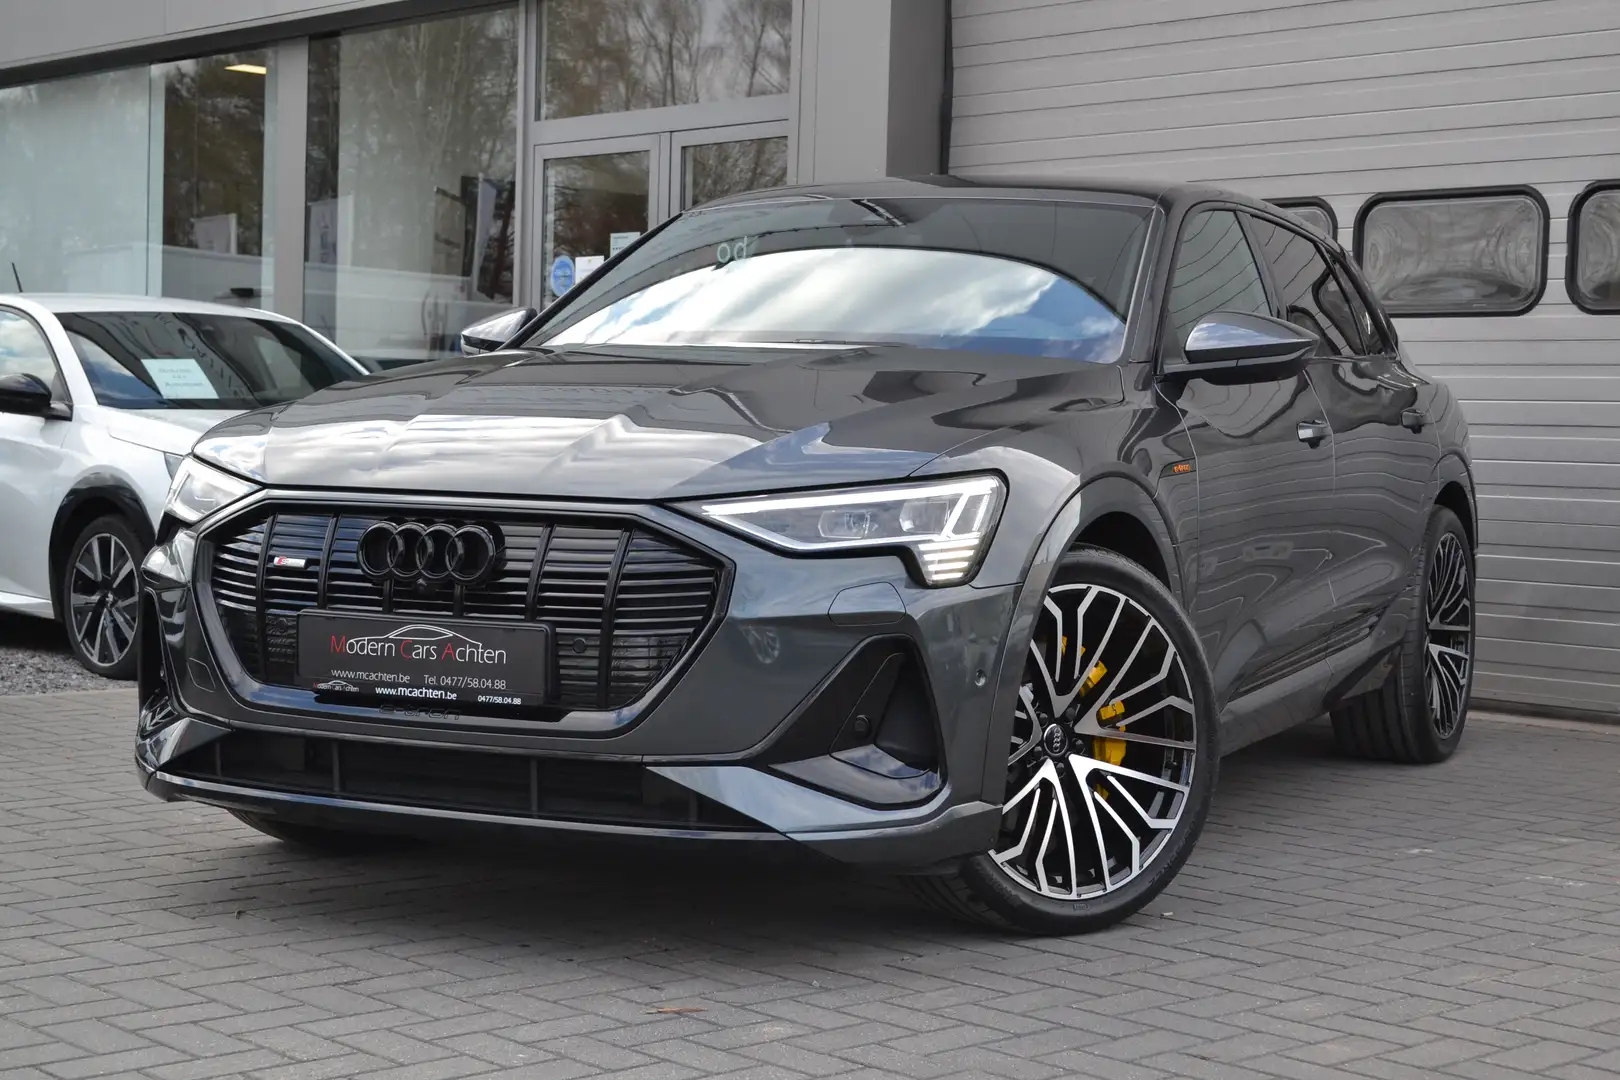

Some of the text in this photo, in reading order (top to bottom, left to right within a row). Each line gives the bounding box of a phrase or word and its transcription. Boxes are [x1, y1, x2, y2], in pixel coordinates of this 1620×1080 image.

[330, 635, 507, 664] Modern Cars Achten
[331, 669, 507, 690] www.mcachten.be Tel. 0477/58.04.88
[375, 686, 522, 705] www.mcachten.be 0477/58.04.88
